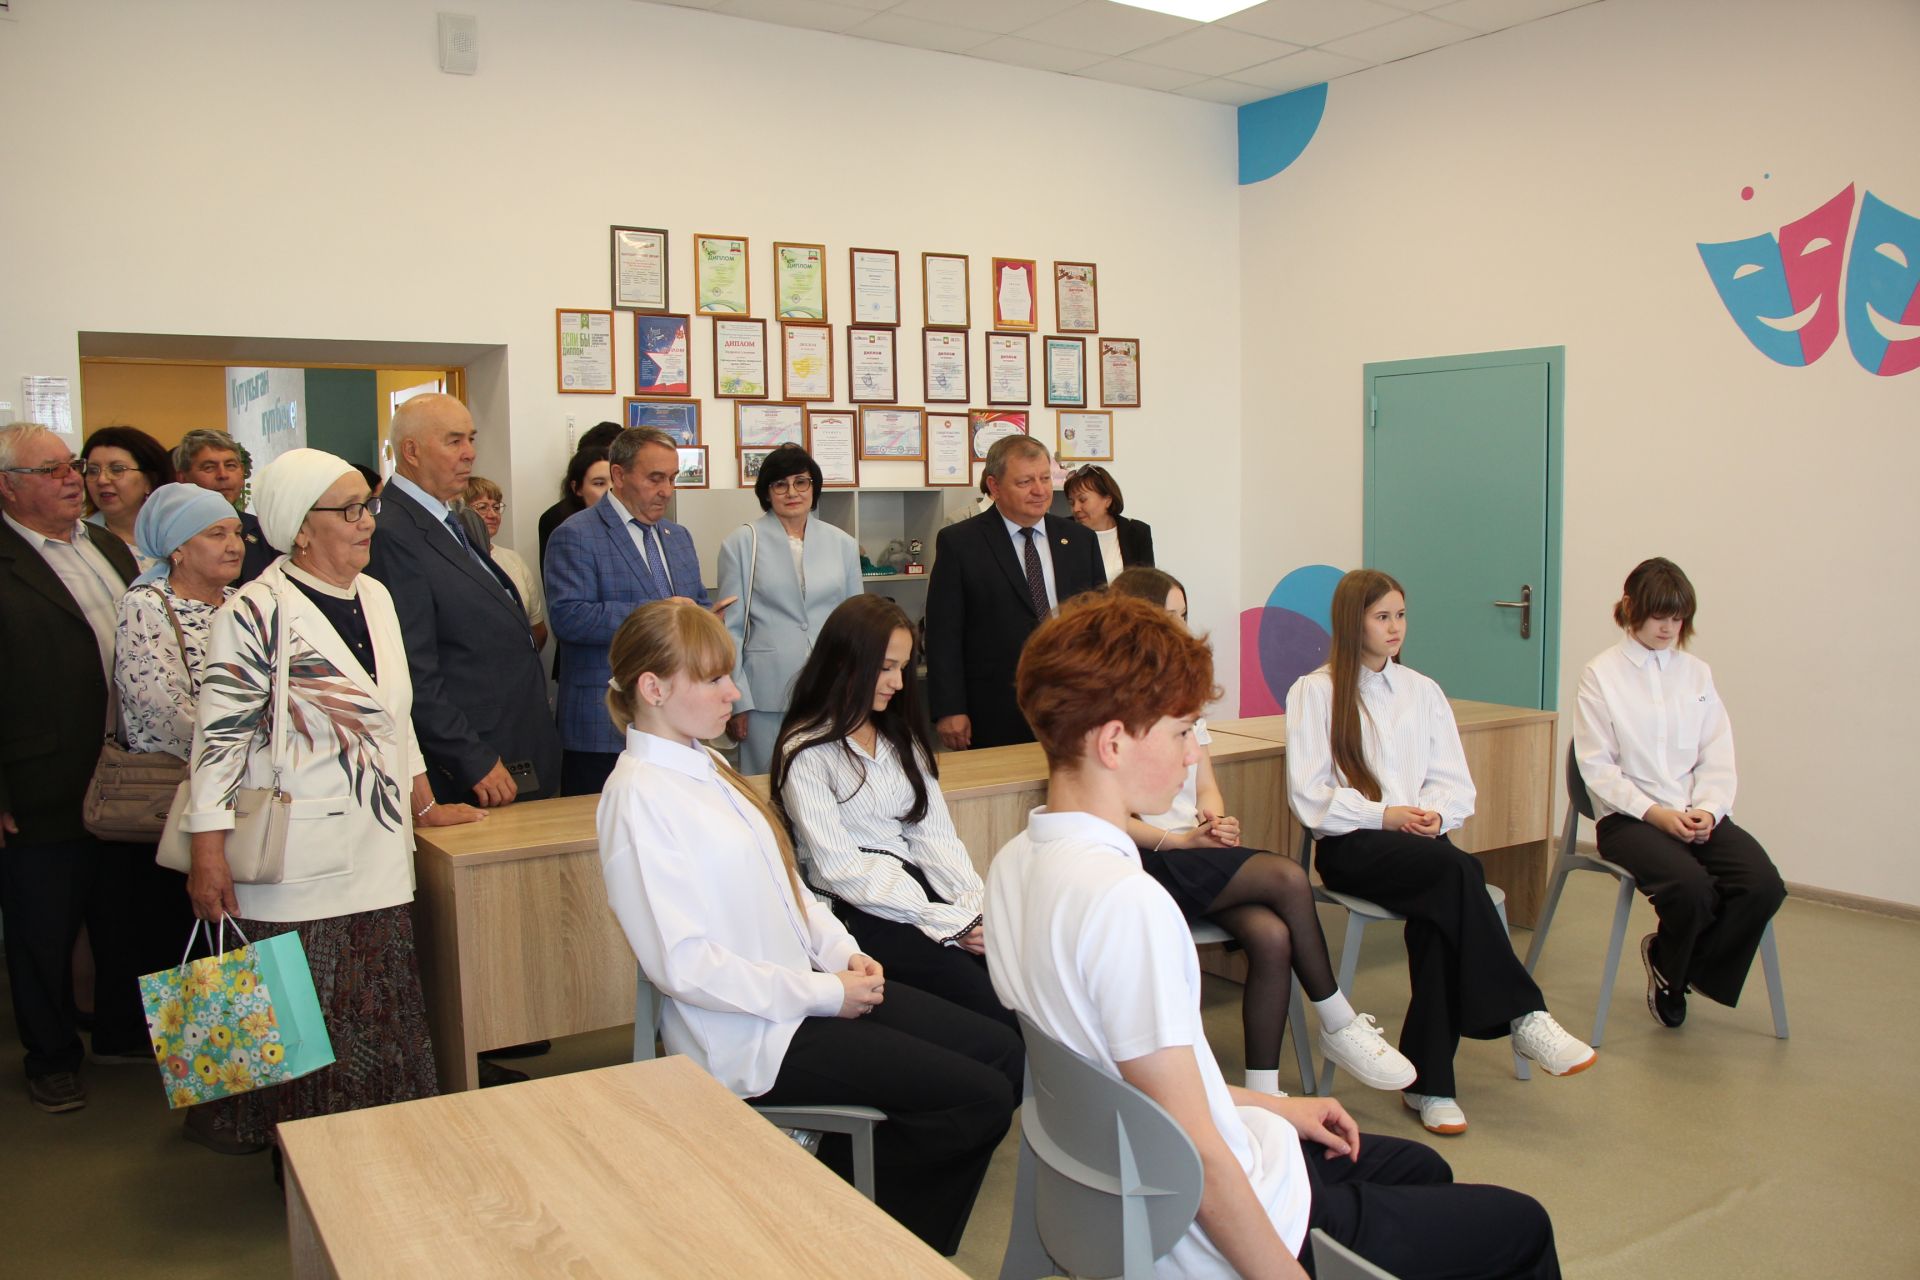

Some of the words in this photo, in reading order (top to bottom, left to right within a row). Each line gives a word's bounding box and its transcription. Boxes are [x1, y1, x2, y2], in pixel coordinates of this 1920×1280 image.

[563, 332, 579, 347] ЕСЛИ
[580, 332, 590, 347] БЫ
[725, 340, 755, 348] ДИПЛОМ
[563, 347, 584, 356] ДИПЛОМ
